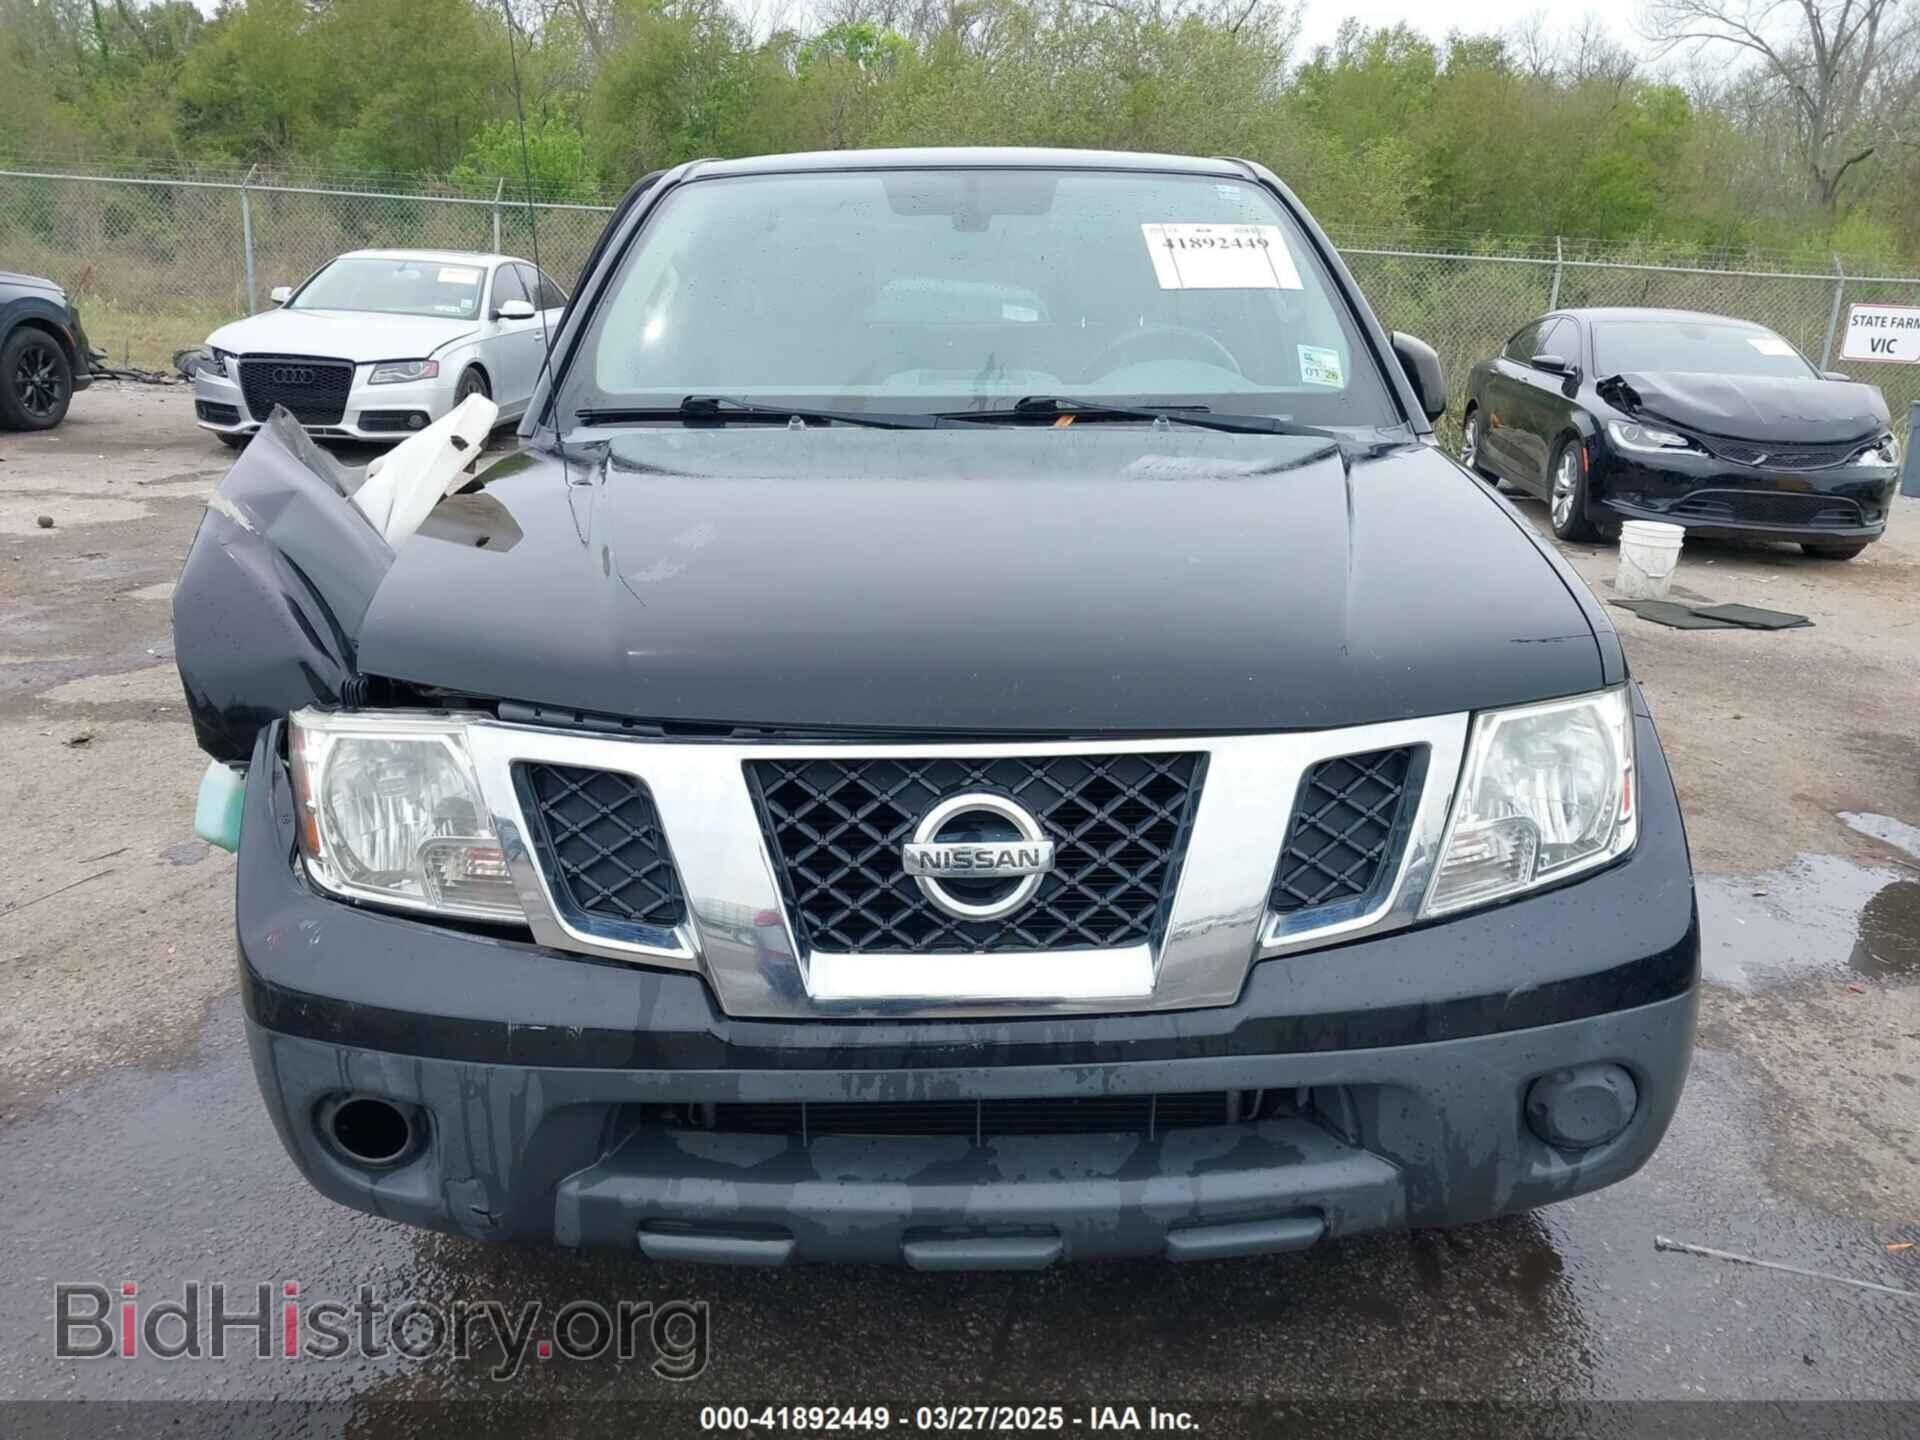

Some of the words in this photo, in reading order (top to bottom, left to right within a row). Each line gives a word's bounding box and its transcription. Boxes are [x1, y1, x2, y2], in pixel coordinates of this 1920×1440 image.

[1162, 237, 1270, 249] 41892449
[1851, 315, 1888, 328] STATE
[1870, 337, 1898, 354] VIC
[919, 848, 1040, 869] NISSAN
